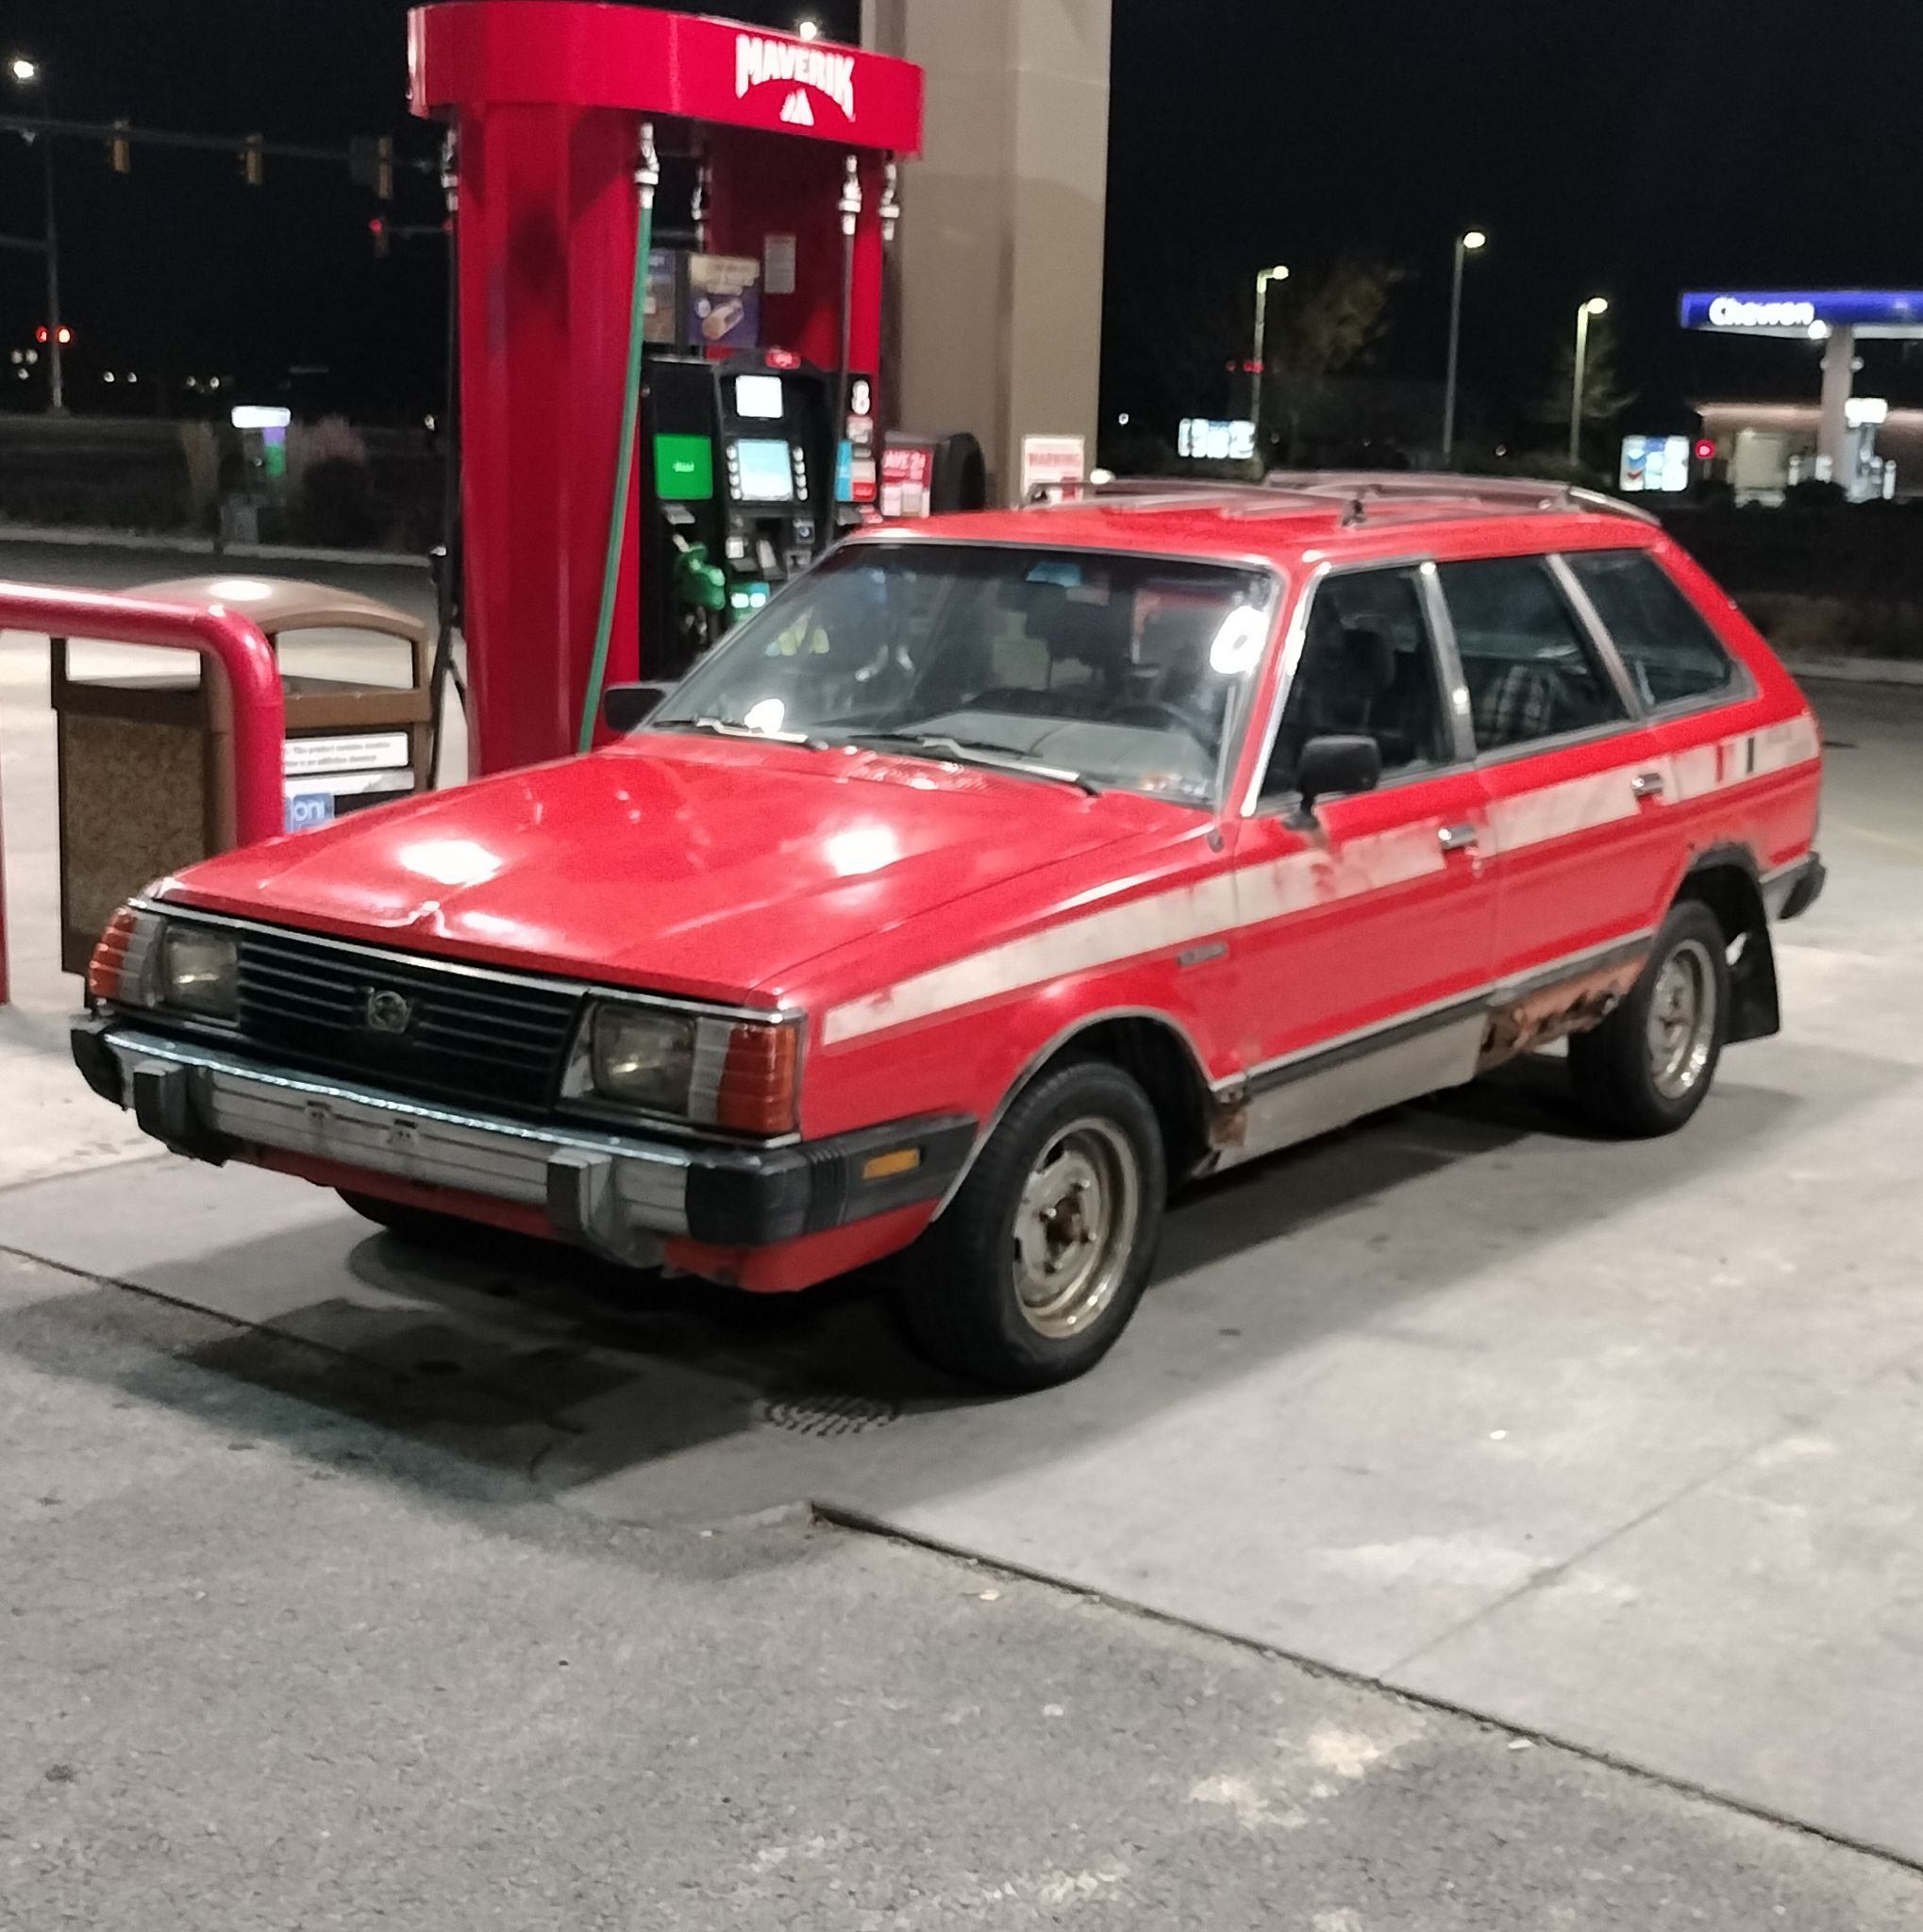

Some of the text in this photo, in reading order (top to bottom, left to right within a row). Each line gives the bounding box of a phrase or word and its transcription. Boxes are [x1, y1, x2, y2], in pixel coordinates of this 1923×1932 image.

[735, 34, 856, 122] MAVERIK
[1709, 297, 1814, 325] Chevron
[851, 379, 870, 415] 8
